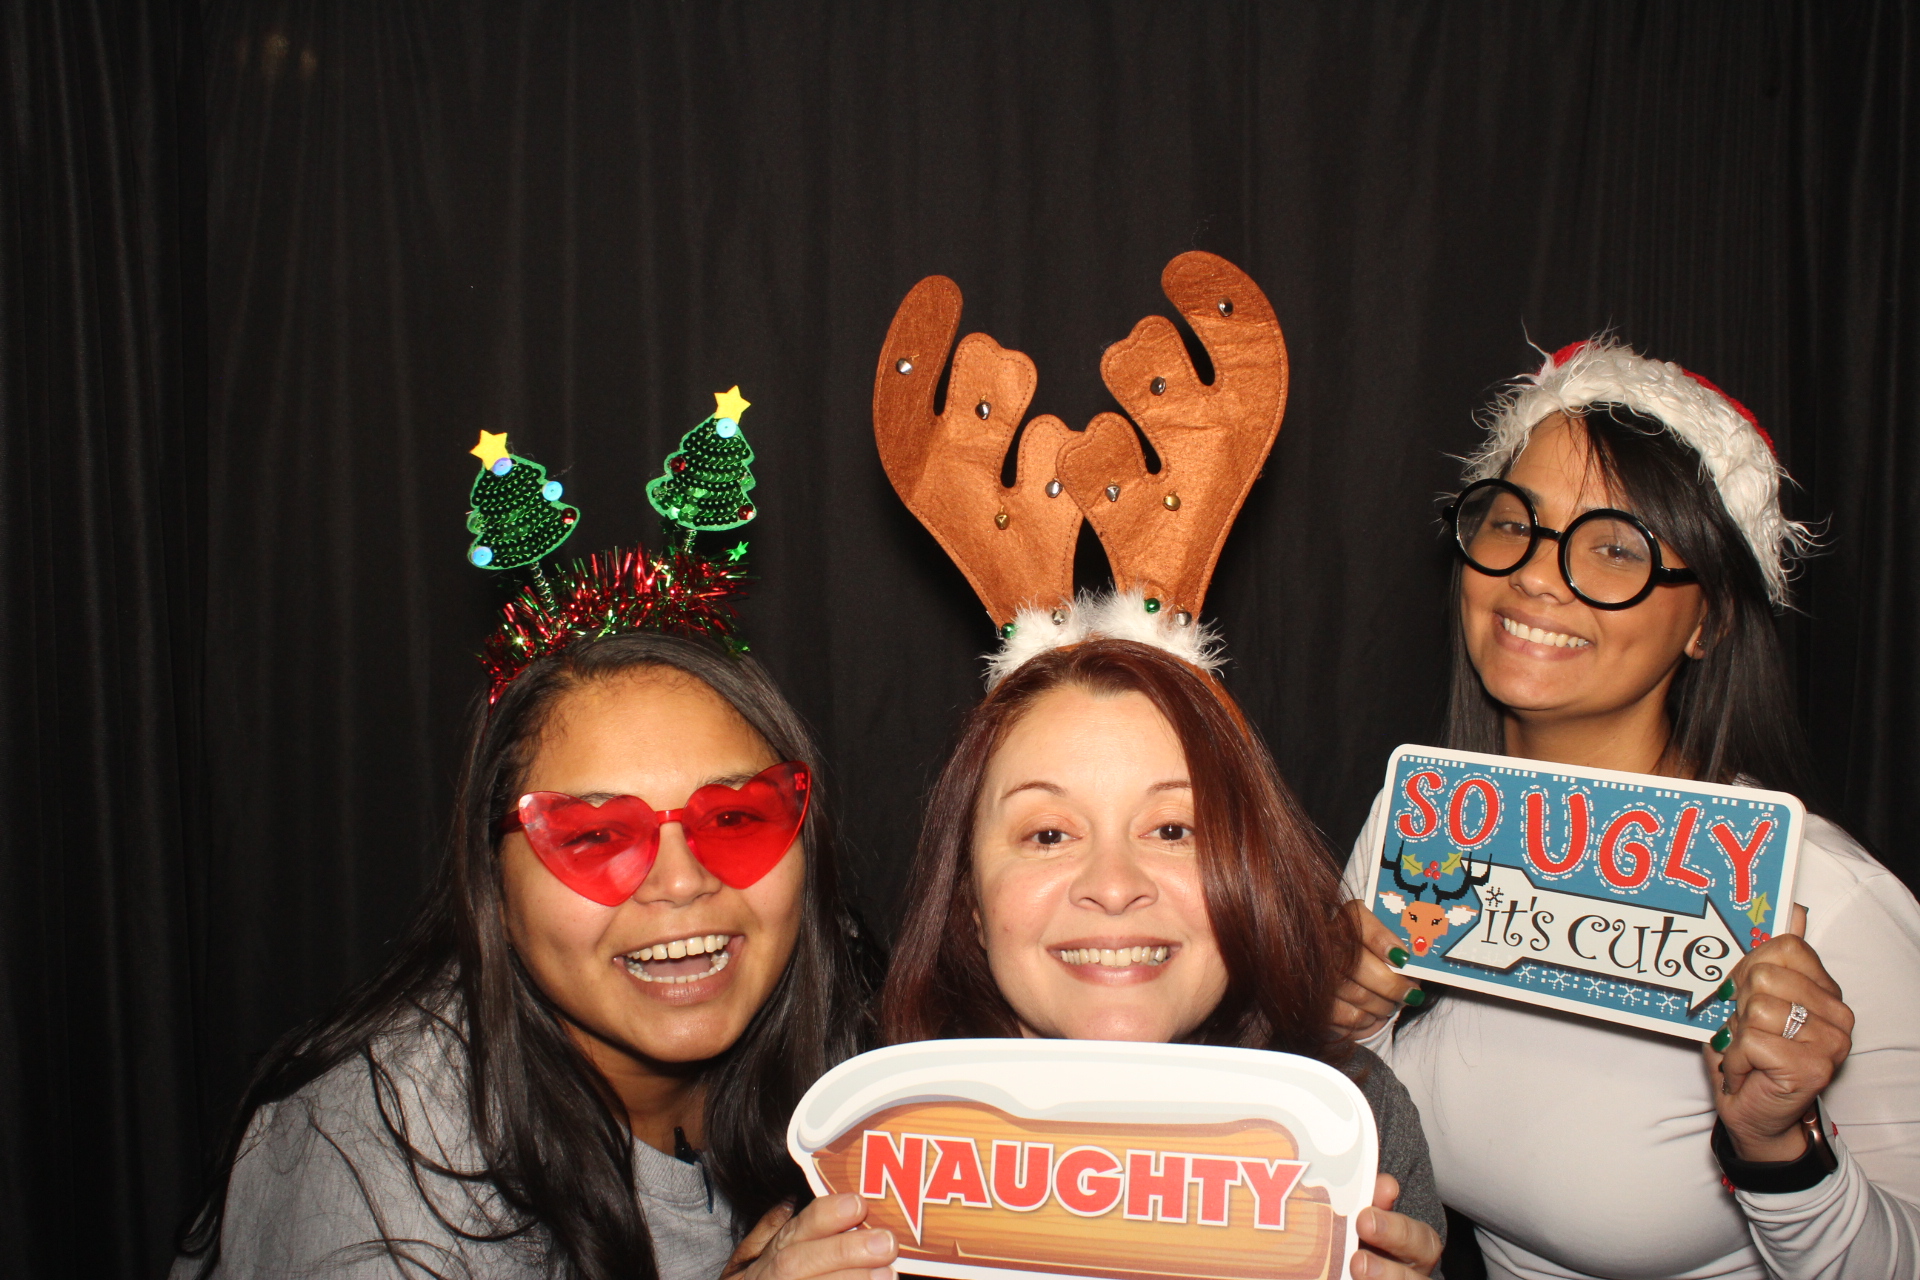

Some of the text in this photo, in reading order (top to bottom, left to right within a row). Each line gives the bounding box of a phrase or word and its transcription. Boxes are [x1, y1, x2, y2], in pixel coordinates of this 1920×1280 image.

[1397, 769, 1774, 905] SO UGLY
[1480, 890, 1732, 982] it's cute
[860, 1130, 1311, 1246] NAUGHTY
